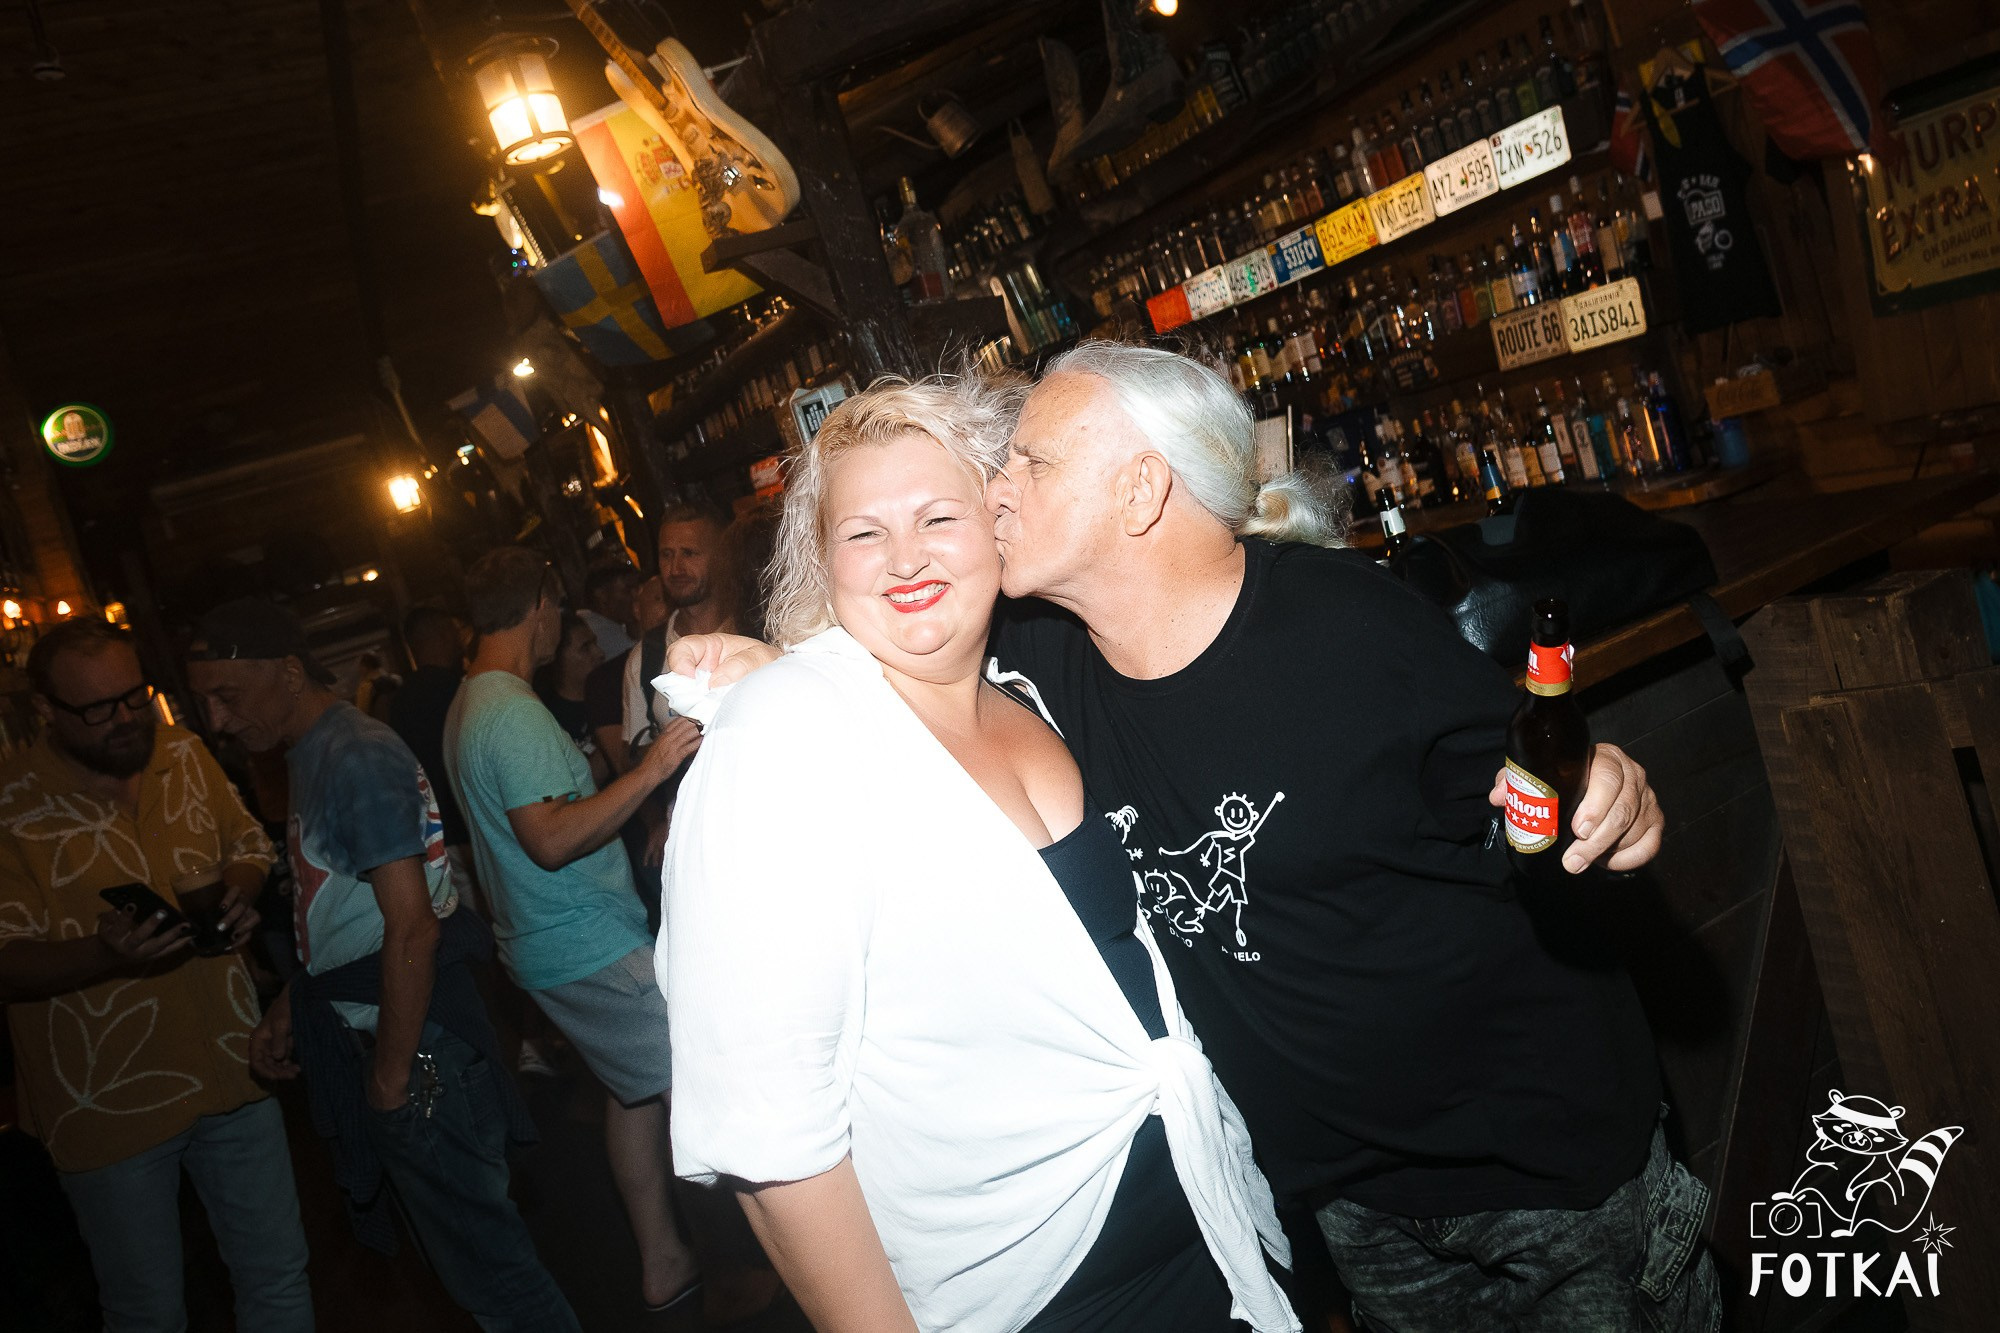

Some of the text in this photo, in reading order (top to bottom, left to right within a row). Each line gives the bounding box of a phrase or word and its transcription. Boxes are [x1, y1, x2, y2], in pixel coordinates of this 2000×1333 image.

[1495, 142, 1525, 175] ZXN
[1532, 126, 1562, 159] 526
[1432, 172, 1455, 204] AYZ
[1880, 176, 1990, 264] EXTRA
[1497, 311, 1562, 357] ROUTE 66
[1570, 300, 1640, 342] 3AIS841
[1505, 792, 1551, 820] ahou
